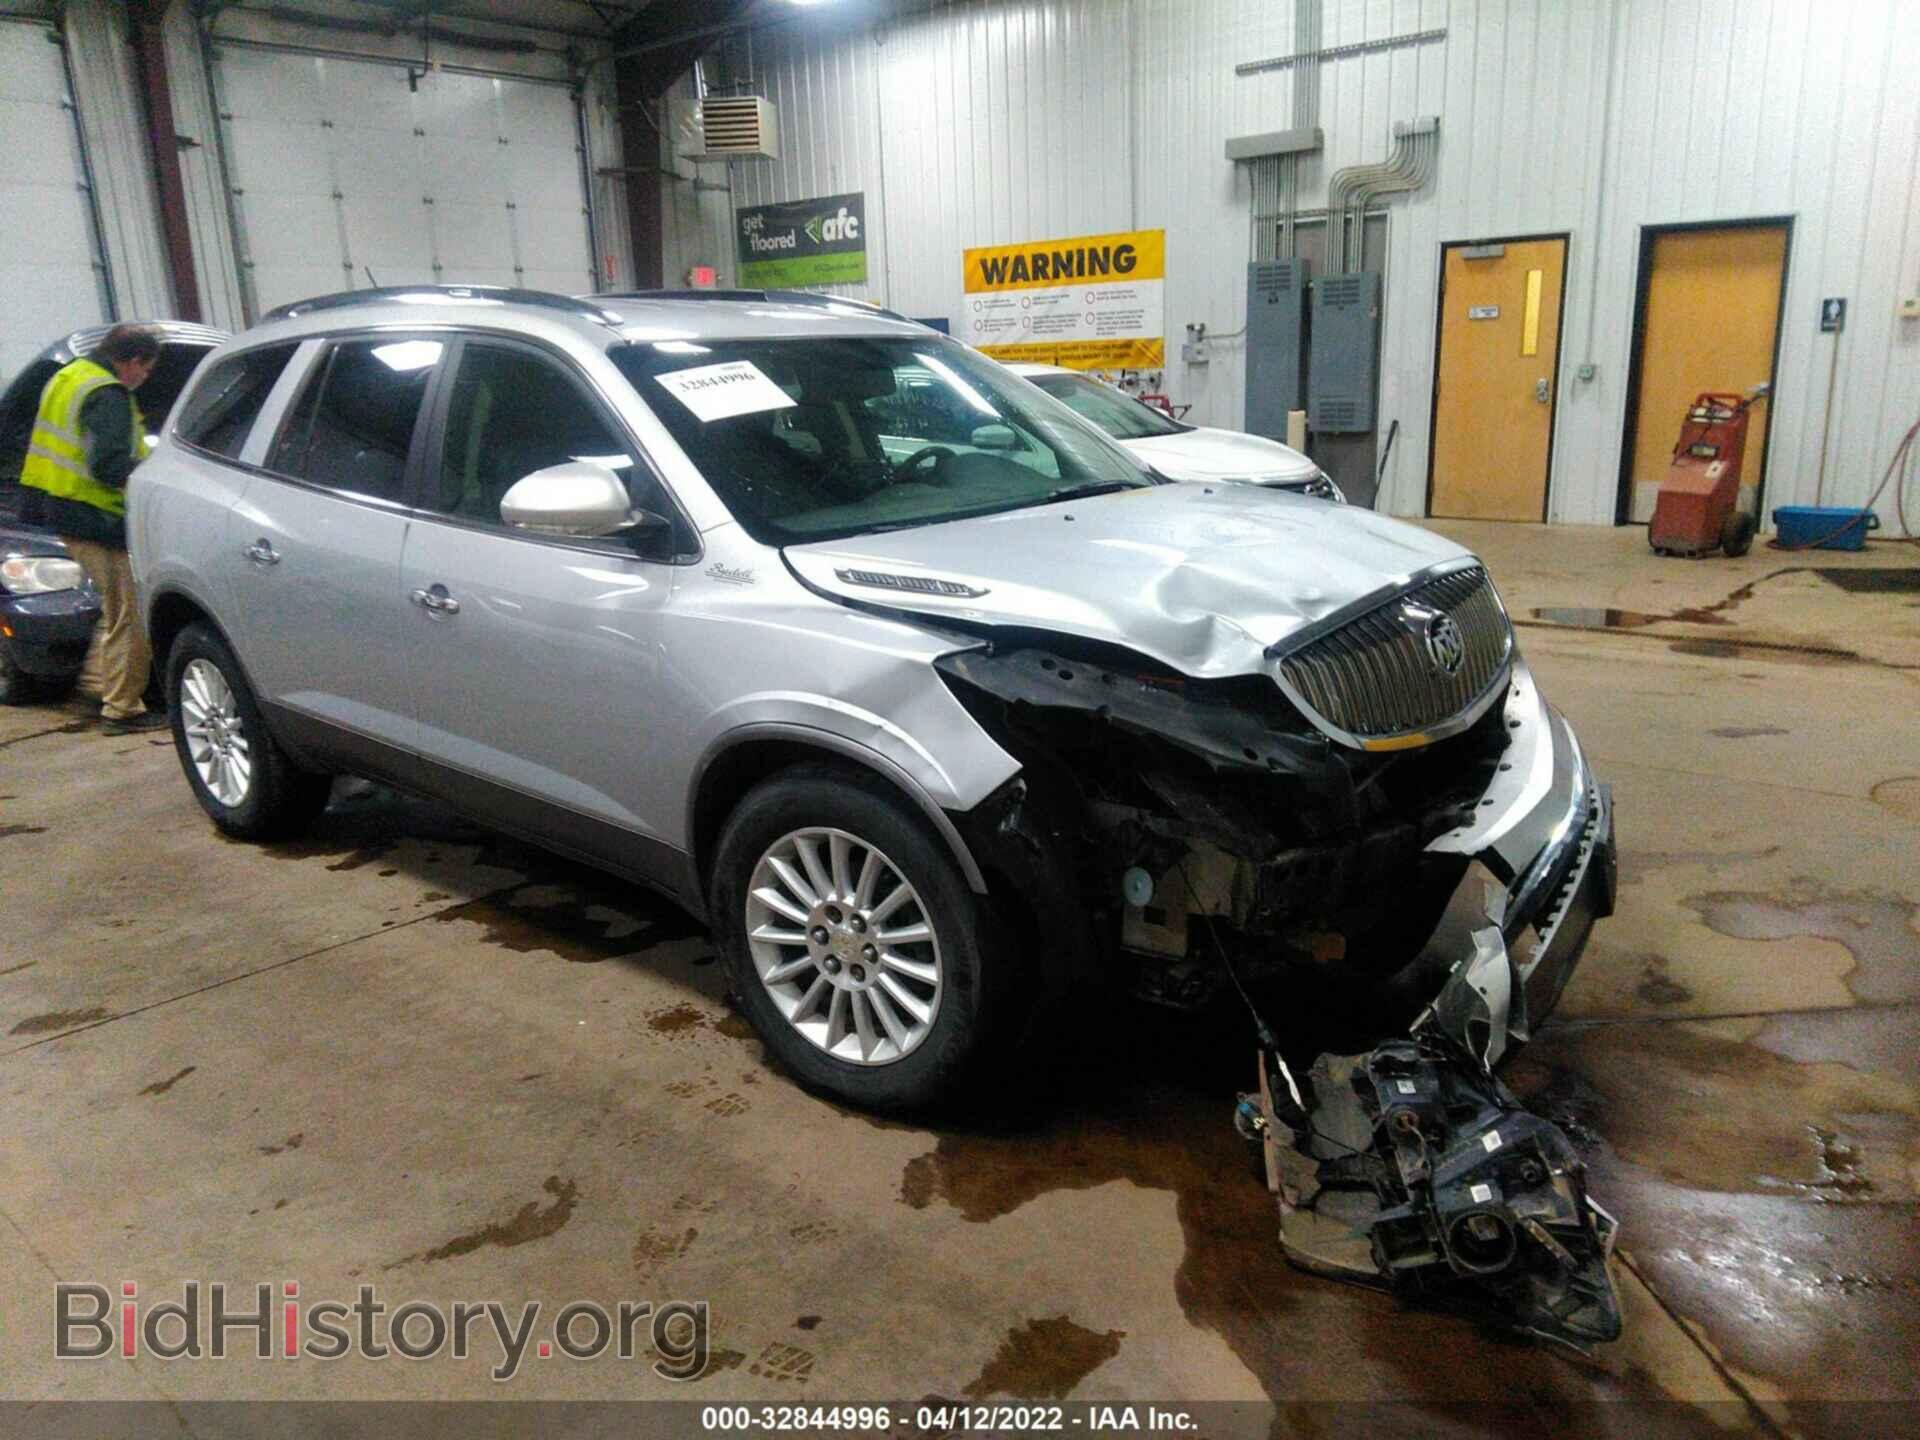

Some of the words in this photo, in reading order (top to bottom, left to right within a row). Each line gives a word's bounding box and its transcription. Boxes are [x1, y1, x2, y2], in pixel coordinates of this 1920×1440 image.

[743, 213, 765, 236] get
[822, 207, 860, 242] afc
[751, 228, 796, 251] floored
[980, 244, 1138, 285] WARNING
